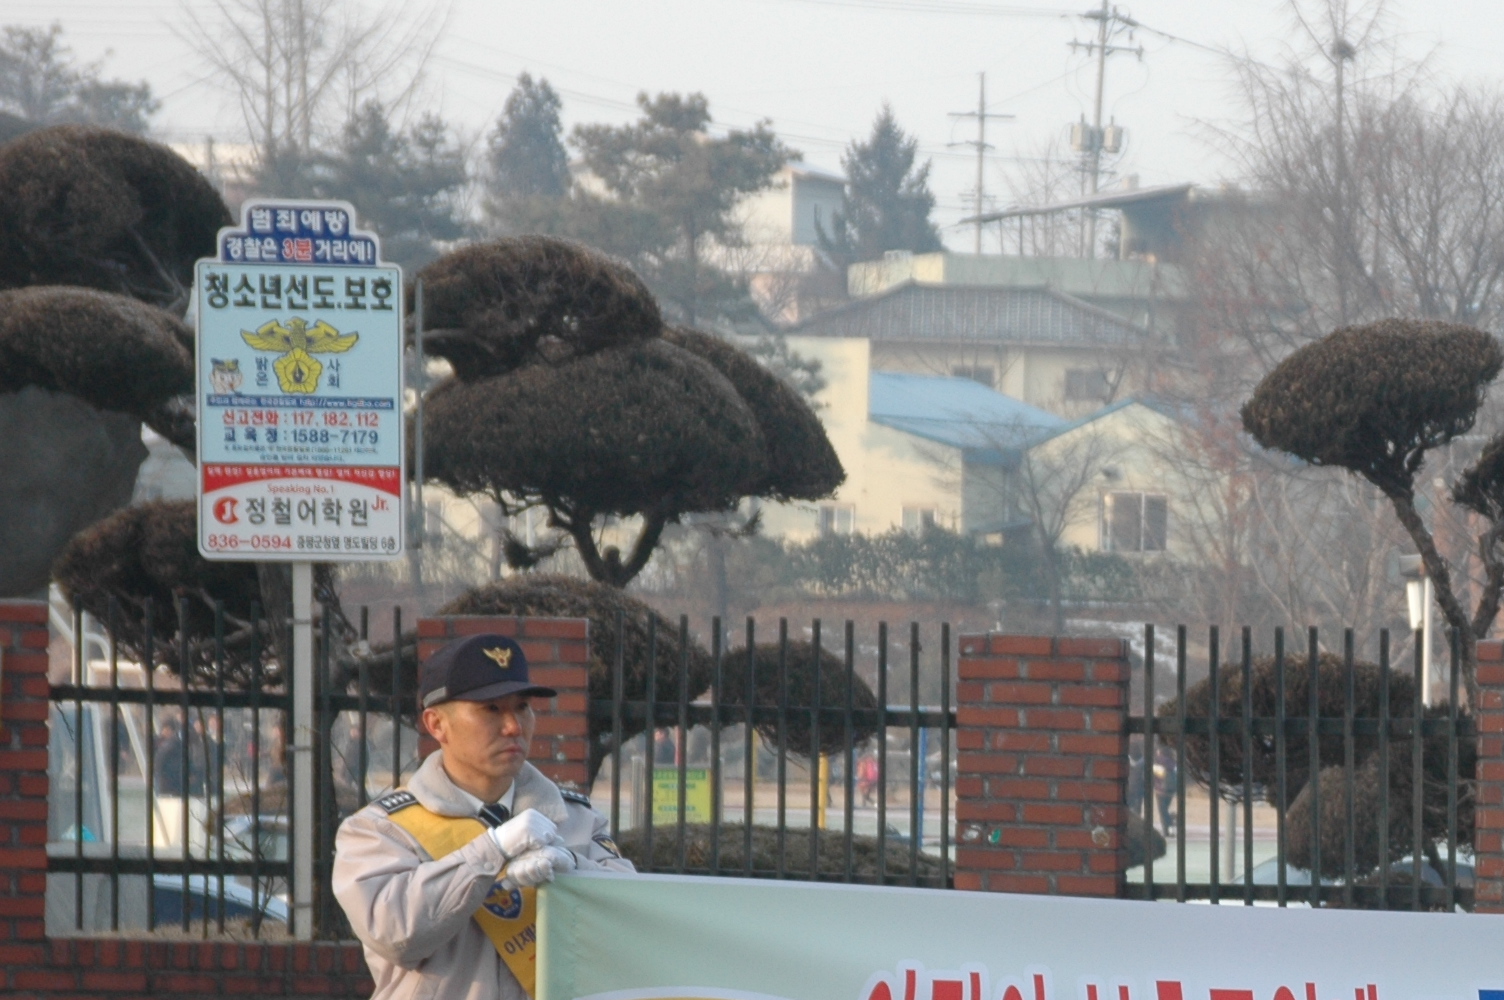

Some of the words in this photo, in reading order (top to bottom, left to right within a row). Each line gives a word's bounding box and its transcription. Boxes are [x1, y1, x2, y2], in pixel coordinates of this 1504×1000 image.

[251, 209, 345, 233] 범죄예방
[226, 237, 277, 260] 경찰은
[282, 237, 312, 261] 3분
[222, 410, 279, 427] 신고전화
[291, 429, 379, 444] 1588-7179
[245, 497, 369, 527] 정철어학원
[208, 534, 291, 549] 836-0594
